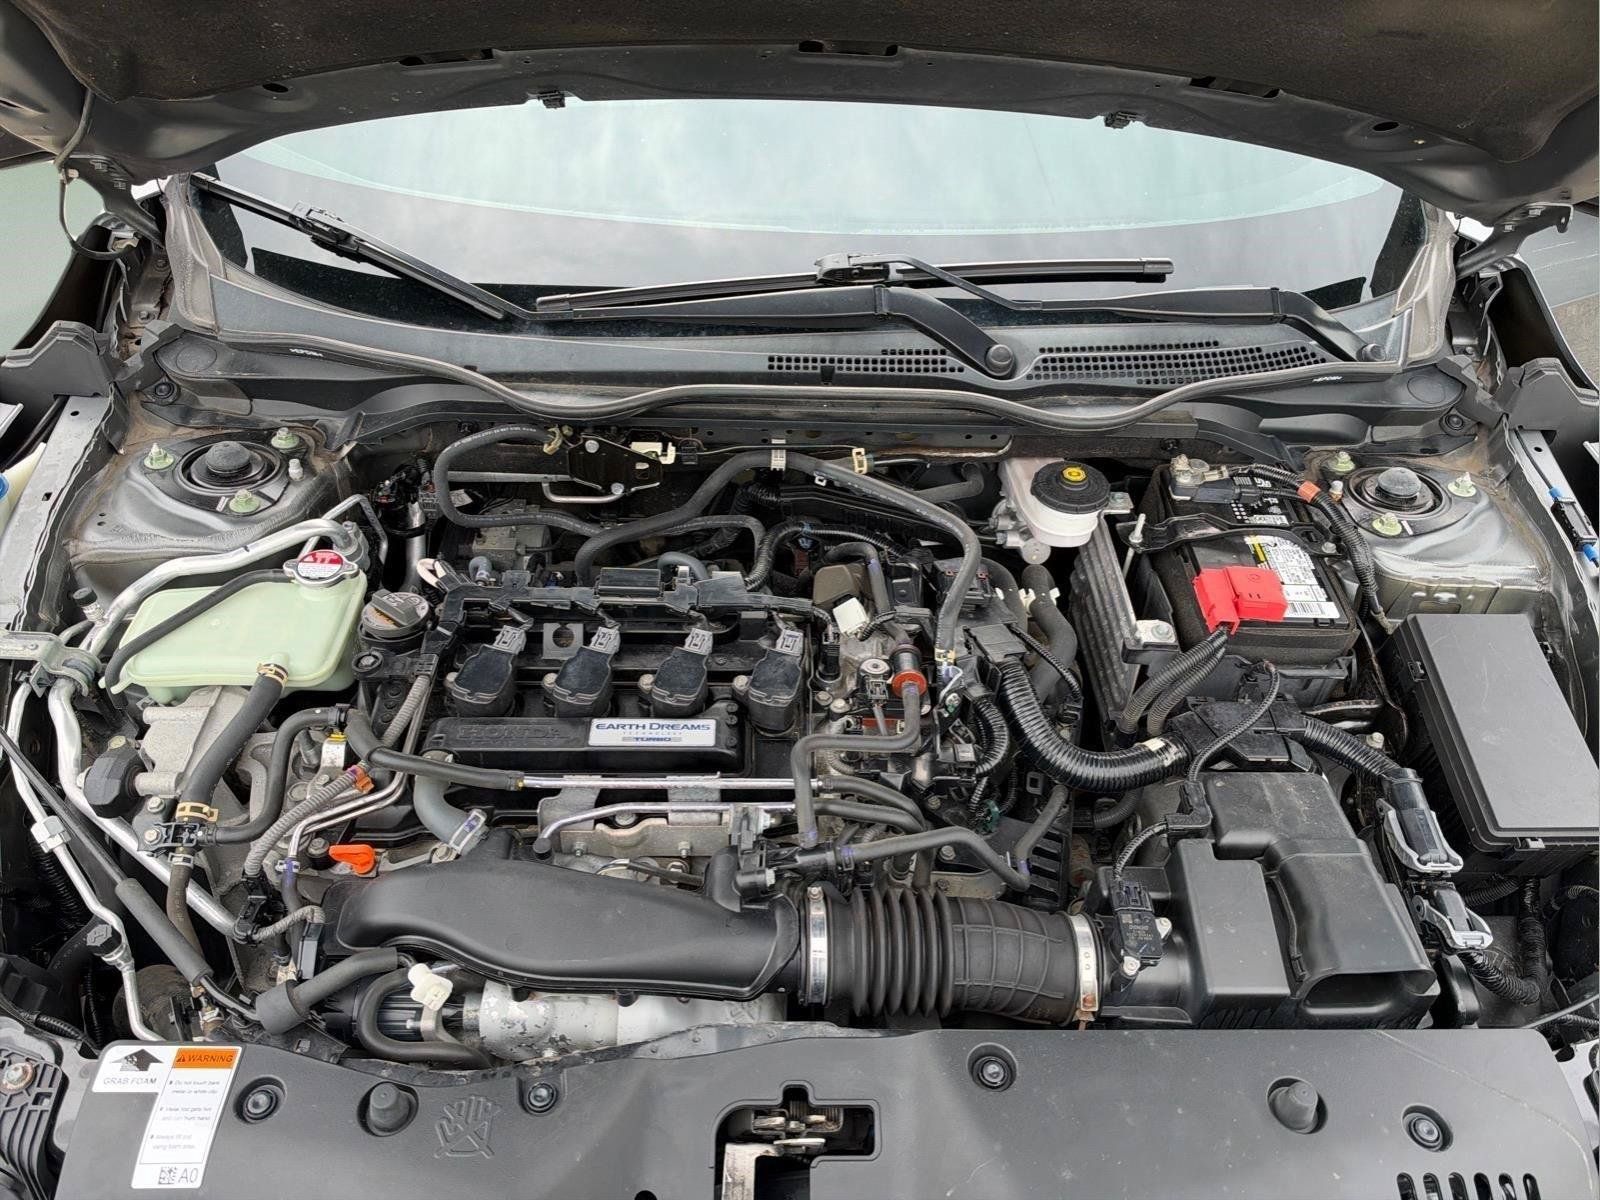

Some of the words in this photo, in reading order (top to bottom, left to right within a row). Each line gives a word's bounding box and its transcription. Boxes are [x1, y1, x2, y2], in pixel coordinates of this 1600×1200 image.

[649, 722, 711, 730] DREAMS
[458, 725, 566, 739] HONDA
[188, 1054, 233, 1063] WARNING
[103, 1077, 129, 1086] GRAB
[130, 1077, 157, 1085] FOAM
[178, 1167, 199, 1184] A0
